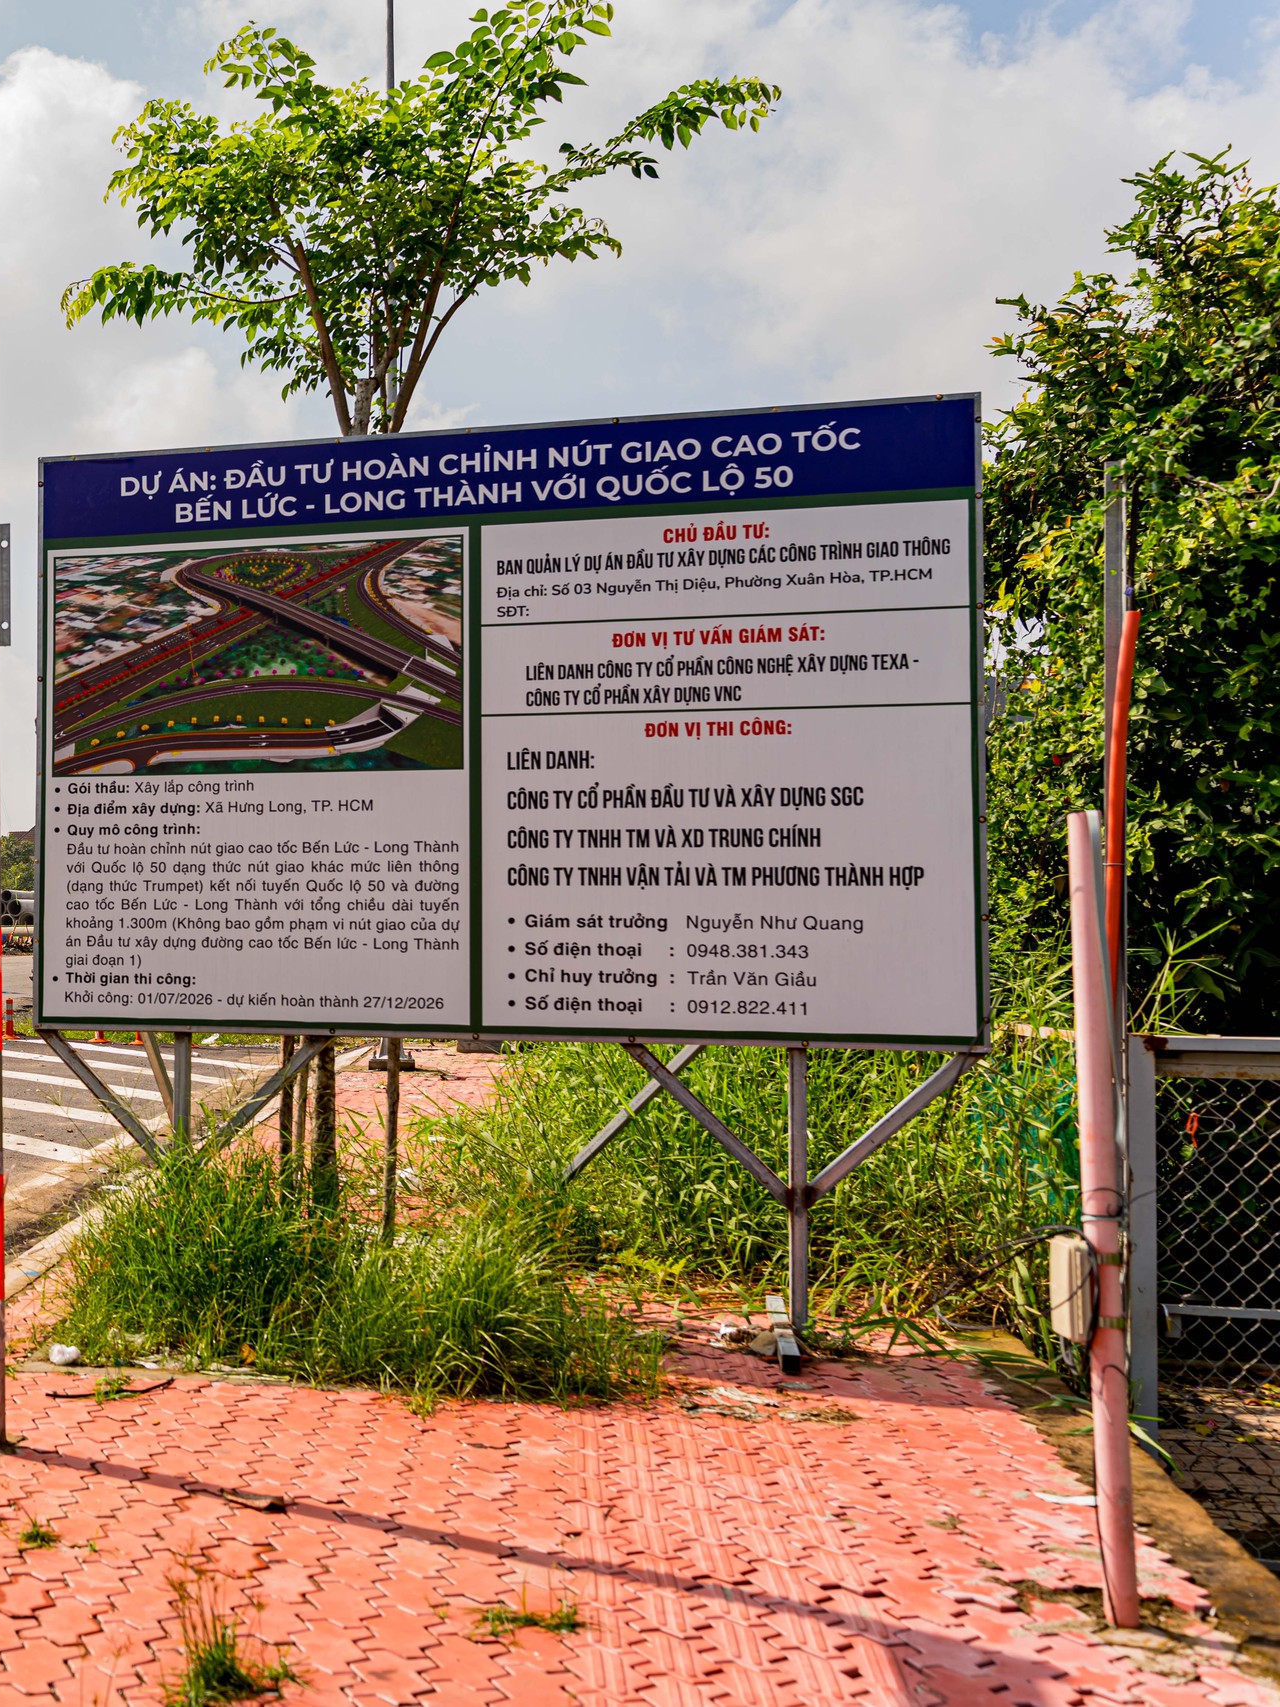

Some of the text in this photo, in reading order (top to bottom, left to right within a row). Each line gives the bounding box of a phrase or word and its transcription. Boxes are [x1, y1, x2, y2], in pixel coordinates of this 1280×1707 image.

[121, 421, 860, 500] DỰ ÁN: ĐẦU TƯ HOÀN CHỈNH NÚT GIAO CAO TỐC
[176, 494, 231, 523] BẾN
[242, 492, 297, 519] LỨC
[325, 489, 405, 514] LONG
[414, 480, 521, 508] THÀNH
[531, 473, 585, 501] VỚI
[596, 469, 692, 501] QUỐC
[703, 463, 744, 496] LỘ
[754, 466, 793, 488] 50
[663, 521, 769, 543] CHỦ ĐẦU TƯ:
[497, 536, 950, 575] BAN QUẢN LÝ DỰ ÁN ĐẦU TƯ XÂY DỰNG CÁC CÔNG TRÌNH GIAO THÔNG
[496, 568, 932, 600] Địa chỉ: Số 03 Nguyễn Thị Diệu, Phường Xuân Hòa, TP.HCM
[497, 606, 529, 617] SĐT:
[612, 623, 824, 649] ĐƠN VỊ TƯ VẤN GIÁM SÁT:
[644, 717, 792, 740] ĐƠN VỊ THI CÔNG:
[508, 748, 594, 770] LIÊN DANH:
[68, 780, 254, 796] Gói thầu: Xây lắp công trình
[68, 823, 200, 838] Quy mô công trình:
[508, 824, 820, 848] CÔNG TY TNHH TM VÀ XD TRUNG CHÍNH
[525, 913, 863, 934] Giám sát trưởng Nguyễn Như Quang
[525, 940, 548, 956] Số
[554, 942, 590, 958] điện
[597, 943, 641, 959] thoại
[687, 944, 808, 958] 0948.381.343
[66, 954, 141, 968] giai đoạn 1)
[525, 967, 555, 982] Chỉ
[561, 970, 592, 986] huy
[598, 968, 657, 987] trưởng
[687, 970, 726, 985] Trần
[734, 972, 768, 986] Văn
[775, 971, 816, 987] Giầu
[65, 990, 93, 1002] Khởi
[98, 992, 132, 1006] công:
[138, 993, 212, 1005] 01/07/2026
[227, 994, 244, 1008] dự
[248, 992, 276, 1006] kiến
[281, 994, 314, 1007] hoàn
[320, 996, 358, 1008] thành
[364, 996, 444, 1009] 27/12/2026
